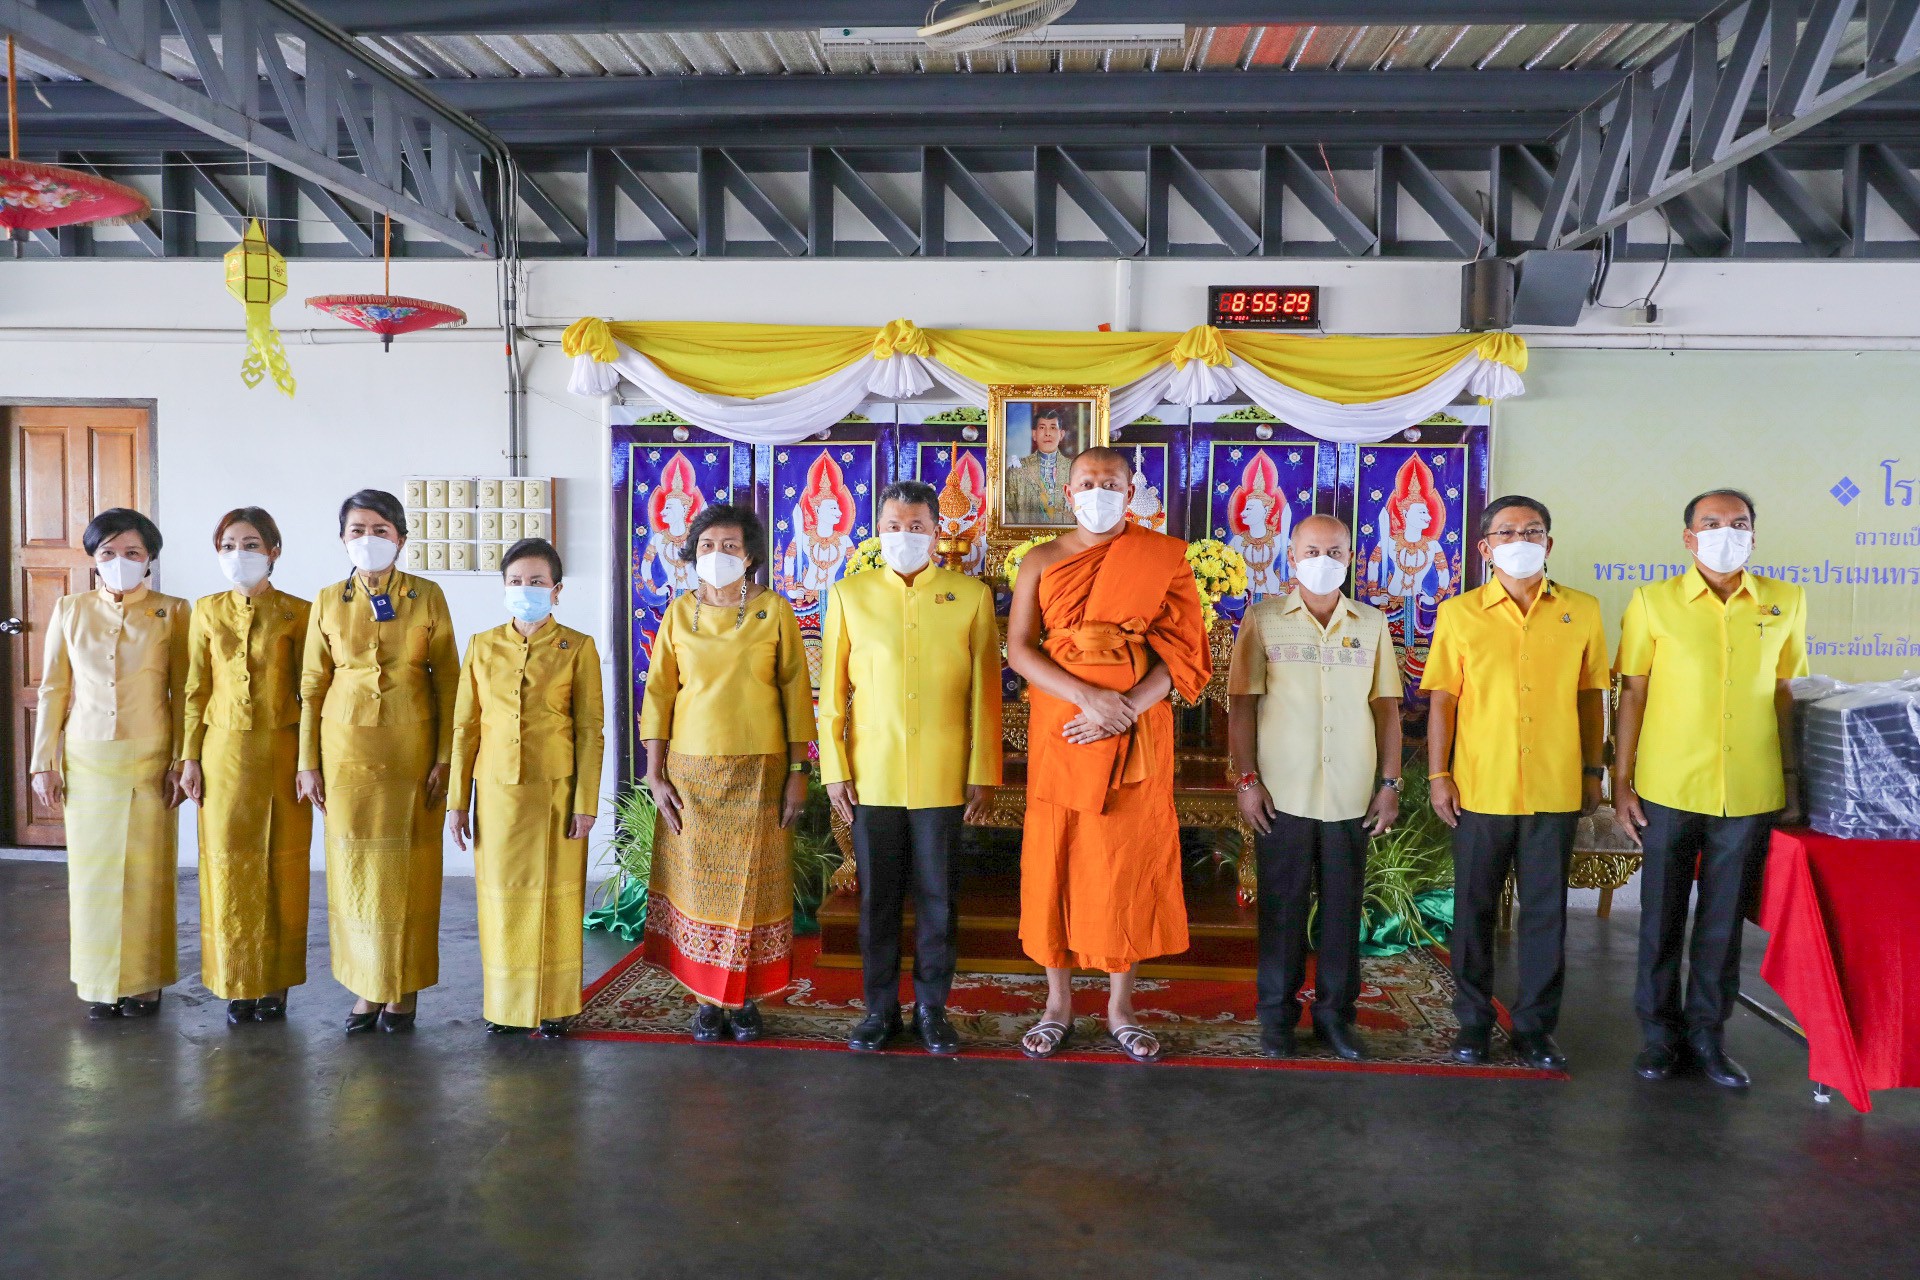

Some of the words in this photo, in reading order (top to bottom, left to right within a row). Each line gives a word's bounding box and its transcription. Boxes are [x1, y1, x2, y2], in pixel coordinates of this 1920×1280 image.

[1230, 293, 1311, 313] 8:55:29
[1880, 458, 1920, 506] โร
[1743, 559, 1920, 585] จพระปรเมนทร
